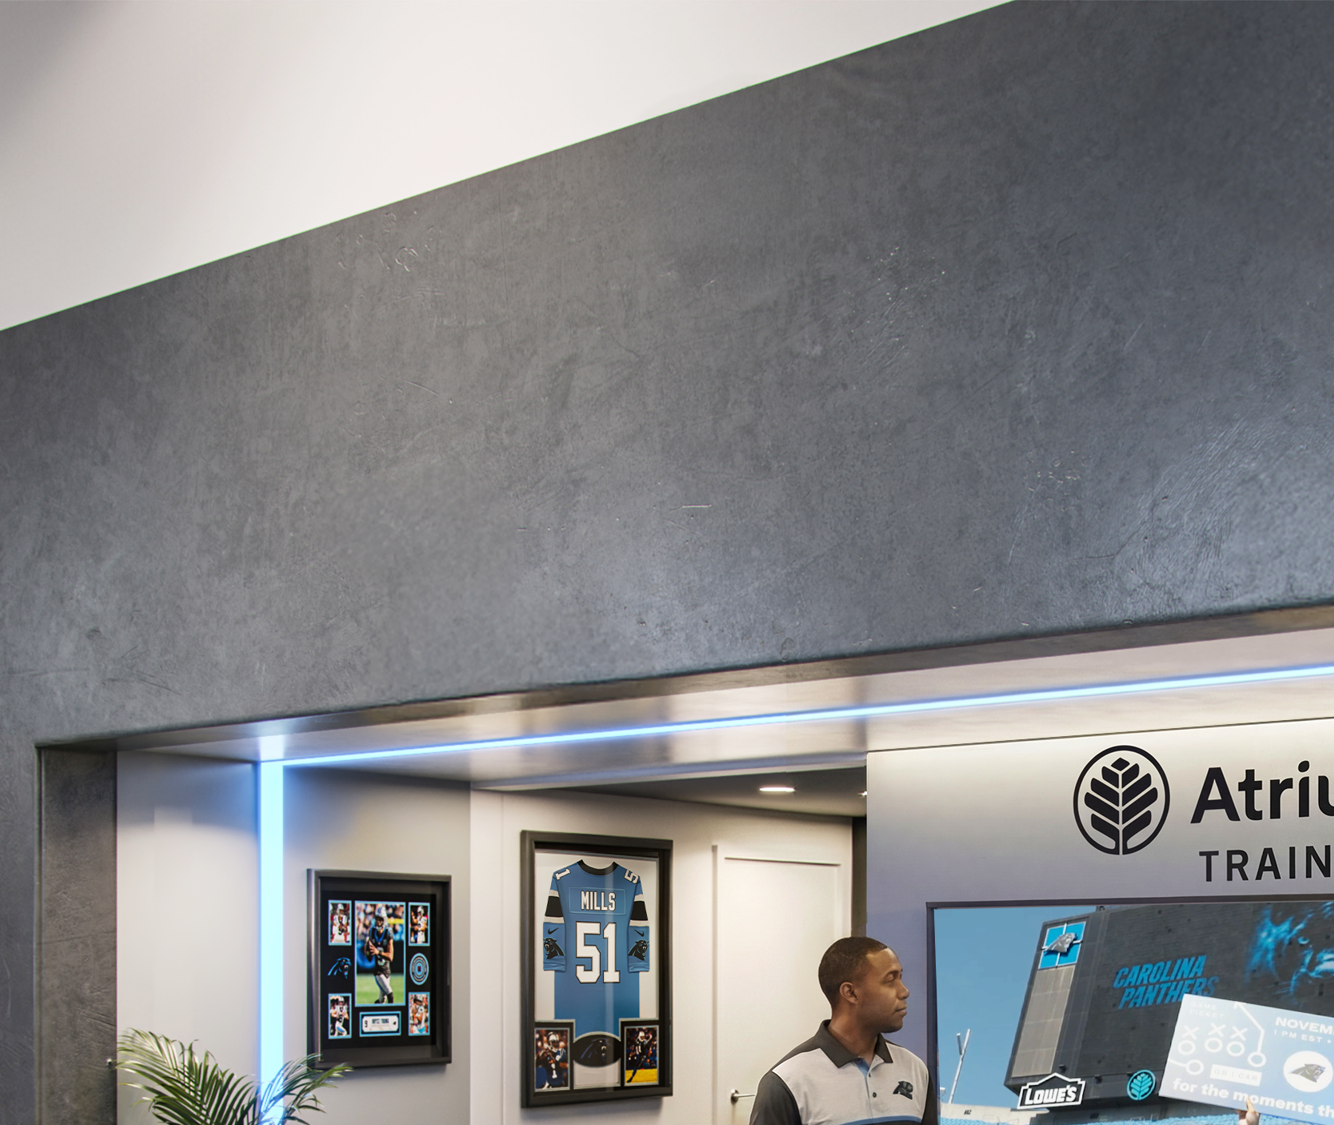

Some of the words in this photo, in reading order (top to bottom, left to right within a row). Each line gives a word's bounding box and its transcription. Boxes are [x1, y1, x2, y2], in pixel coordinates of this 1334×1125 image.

[581, 890, 616, 912] MILLS
[575, 921, 620, 984] 51
[1113, 955, 1207, 989] CAROLINA
[1118, 976, 1220, 1010] PANTHERS
[1282, 1031, 1297, 1039] PM
[1301, 1033, 1323, 1043] EST
[1024, 1086, 1077, 1105] LOWE'S
[1172, 1078, 1198, 1093] for
[1201, 1082, 1229, 1098] the
[1233, 1090, 1314, 1114] moments
